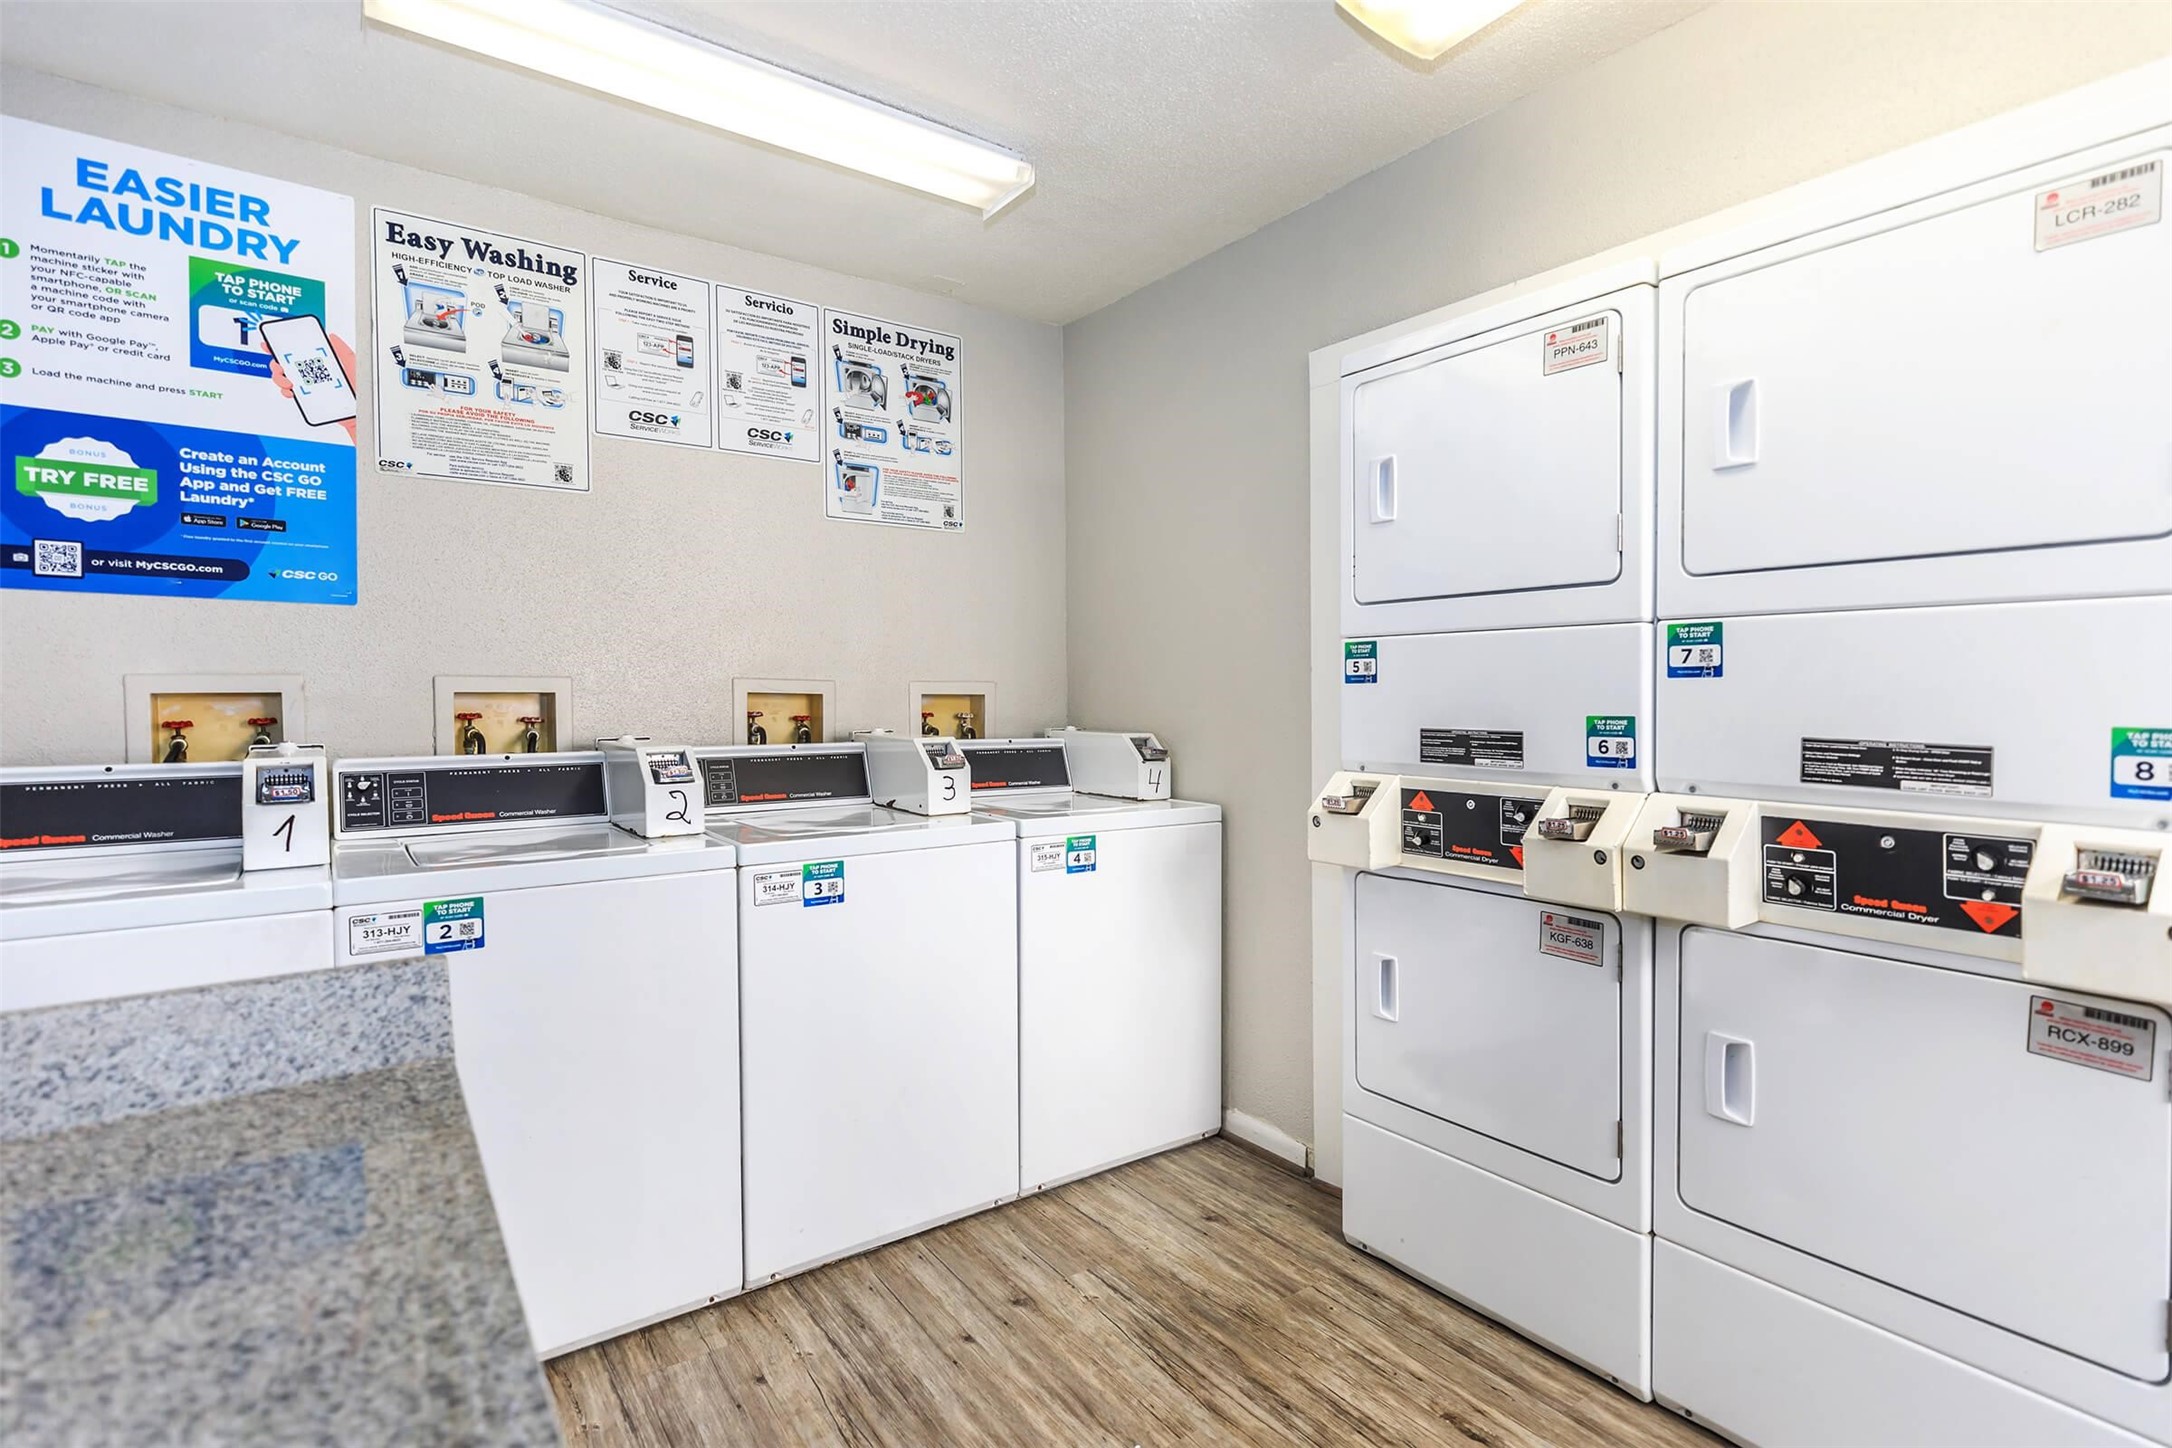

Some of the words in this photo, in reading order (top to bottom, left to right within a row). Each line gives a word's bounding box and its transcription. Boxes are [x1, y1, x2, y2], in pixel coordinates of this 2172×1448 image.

[77, 157, 270, 227] EASIER
[2055, 193, 2141, 227] LCR-282
[41, 187, 300, 265] LAUNDRY
[30, 244, 100, 264] Momentarily
[105, 258, 126, 267] TAP
[129, 263, 146, 271] the
[385, 221, 454, 260] Easy
[461, 237, 577, 286] Washing
[30, 255, 78, 268] machine
[82, 264, 117, 275] sticker
[122, 272, 145, 280] with
[30, 265, 60, 274] your
[60, 269, 131, 287] NFC-capable
[392, 252, 472, 274] HIGH-EFFICIENCY
[487, 271, 506, 280] TOP
[508, 274, 532, 287] LOAD
[534, 280, 571, 294] WASHER
[31, 275, 102, 292] smartphone,
[105, 287, 121, 295] OR
[125, 290, 156, 301] SCAN
[214, 272, 245, 285] TAP
[249, 278, 302, 296] PHONE
[628, 269, 678, 291] Service
[41, 286, 89, 298] machine
[93, 293, 119, 304] code
[123, 300, 146, 308] with
[222, 284, 243, 296] TO
[248, 289, 295, 305] START
[31, 294, 60, 302] your
[60, 299, 127, 315] smartphone
[131, 311, 169, 321] camera
[47, 305, 65, 314] QR
[69, 308, 96, 319] code
[100, 314, 121, 324] app
[259, 303, 278, 311] code
[471, 301, 485, 309] POD
[745, 295, 793, 315] Servicio
[1, 325, 13, 336] 2
[31, 325, 54, 334] PAY
[59, 329, 83, 338] with
[87, 333, 125, 347] Google
[833, 318, 891, 345] Simple
[896, 331, 954, 361] Drying
[32, 335, 65, 348] Apple
[113, 346, 143, 357] credit
[147, 353, 170, 361] card
[1554, 339, 1598, 359] PPN-643
[2, 363, 13, 373] 3
[213, 356, 267, 368] MyCSCGO.com
[916, 356, 941, 366] DRYERS
[32, 368, 60, 378] Load
[65, 372, 82, 381] the
[87, 375, 132, 388] machine
[136, 382, 155, 391] and
[158, 385, 186, 395] press
[190, 389, 223, 399] START
[465, 410, 485, 418] AVOID
[500, 415, 535, 424] FOLLOWING
[629, 410, 668, 425] CSC
[747, 427, 782, 441] CSC
[69, 448, 106, 458] BONUS
[180, 448, 234, 463] Create
[238, 456, 257, 465] an
[262, 458, 325, 473] Account
[180, 462, 226, 478] Using
[231, 468, 257, 479] the
[262, 471, 294, 483] CSC
[299, 476, 321, 486] GO
[379, 460, 405, 469] CSC
[23, 466, 76, 485] TRY
[84, 472, 148, 492] FREE
[180, 477, 215, 490] App
[219, 482, 249, 493] and
[254, 484, 281, 496] Get
[286, 487, 327, 500] FREE
[70, 503, 107, 512] BONUS
[251, 522, 271, 530] Google
[272, 523, 284, 531] Play
[108, 558, 132, 568] visit
[136, 560, 223, 574] MyCSCGO.com
[282, 570, 316, 580] CSC
[318, 572, 338, 582] GO
[1681, 649, 1692, 664] 7
[1353, 661, 1360, 673] 5
[1599, 740, 1609, 754] 6
[1149, 769, 1161, 793] 4
[2135, 761, 2154, 781] 8
[943, 776, 955, 801] 3
[499, 809, 533, 818] Commercial
[535, 807, 557, 815] Washer
[666, 790, 691, 824] 2
[92, 832, 141, 841] Commercial
[273, 814, 295, 852] 1
[1074, 853, 1080, 863] 4
[1444, 851, 1480, 861] Commercial
[1481, 855, 1499, 864] Dryer
[763, 883, 795, 892] 314-HJY
[814, 883, 822, 895] 3
[434, 903, 448, 911] TAP
[1840, 902, 1905, 919] Commercial
[1908, 912, 1939, 923] Dryer
[363, 925, 411, 939] 313-HJY
[440, 924, 452, 939] 2
[1550, 932, 1593, 949] KGF-638
[2047, 1025, 2134, 1056] RCX-899
